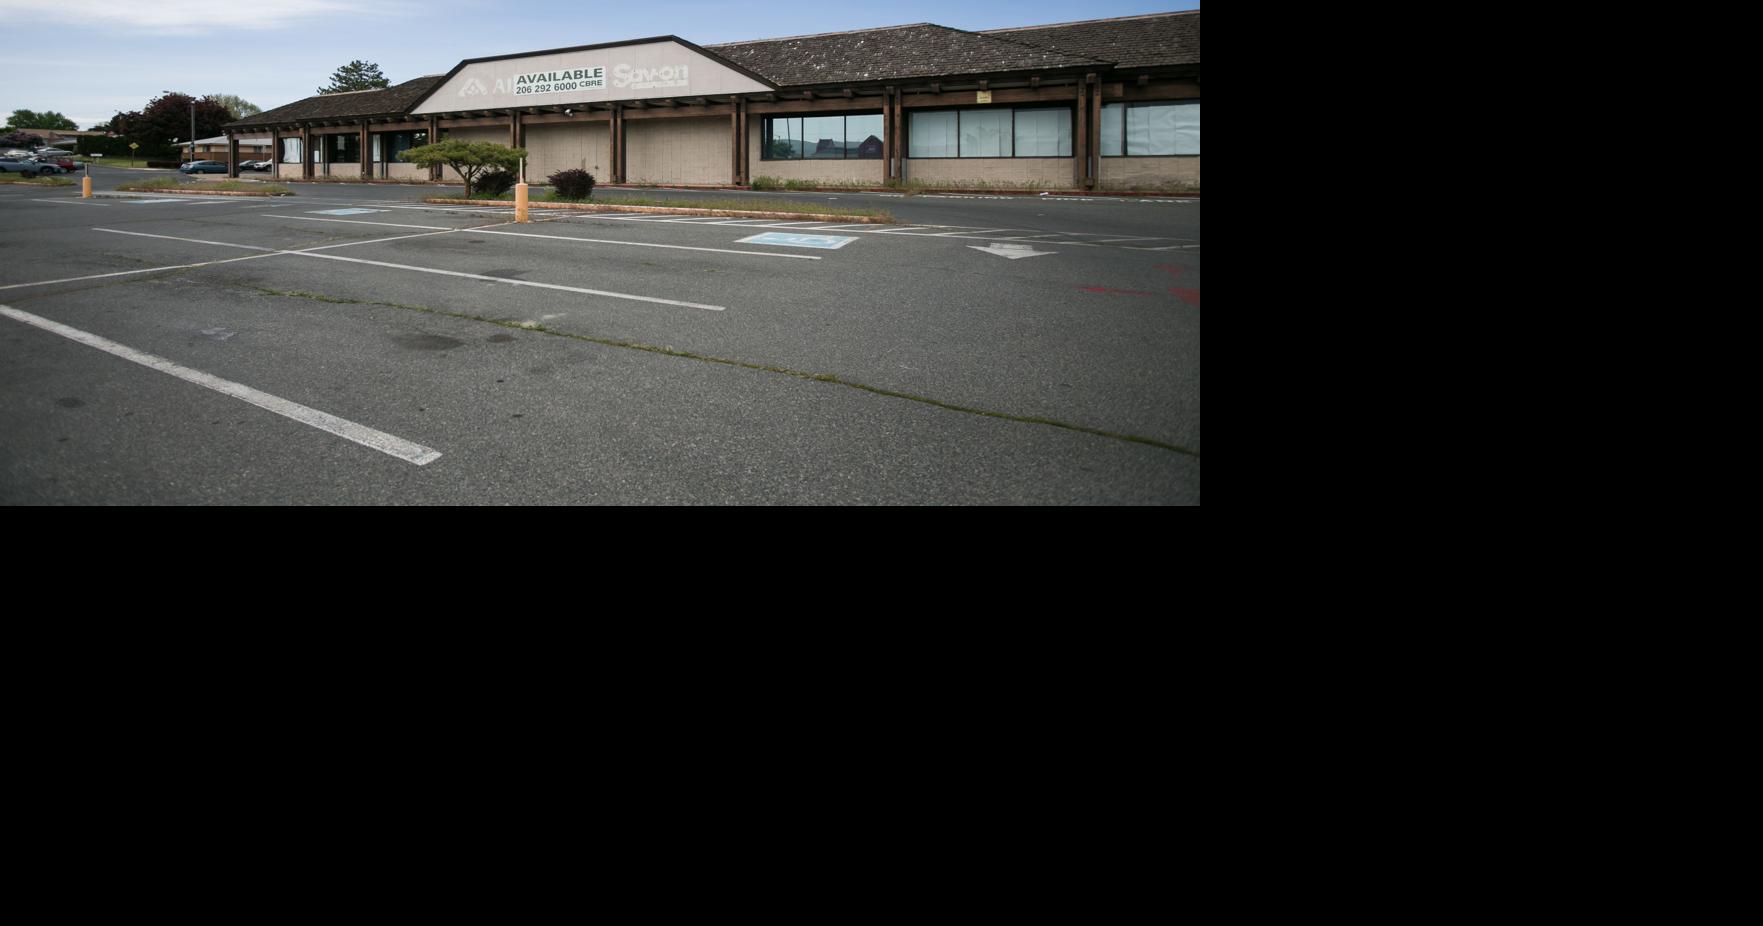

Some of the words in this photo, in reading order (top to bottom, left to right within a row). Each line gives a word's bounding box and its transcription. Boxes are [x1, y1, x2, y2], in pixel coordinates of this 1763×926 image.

[516, 68, 603, 85] AVAILABLE
[516, 86, 532, 95] 206
[535, 84, 551, 93] 292
[554, 82, 577, 91] 6000
